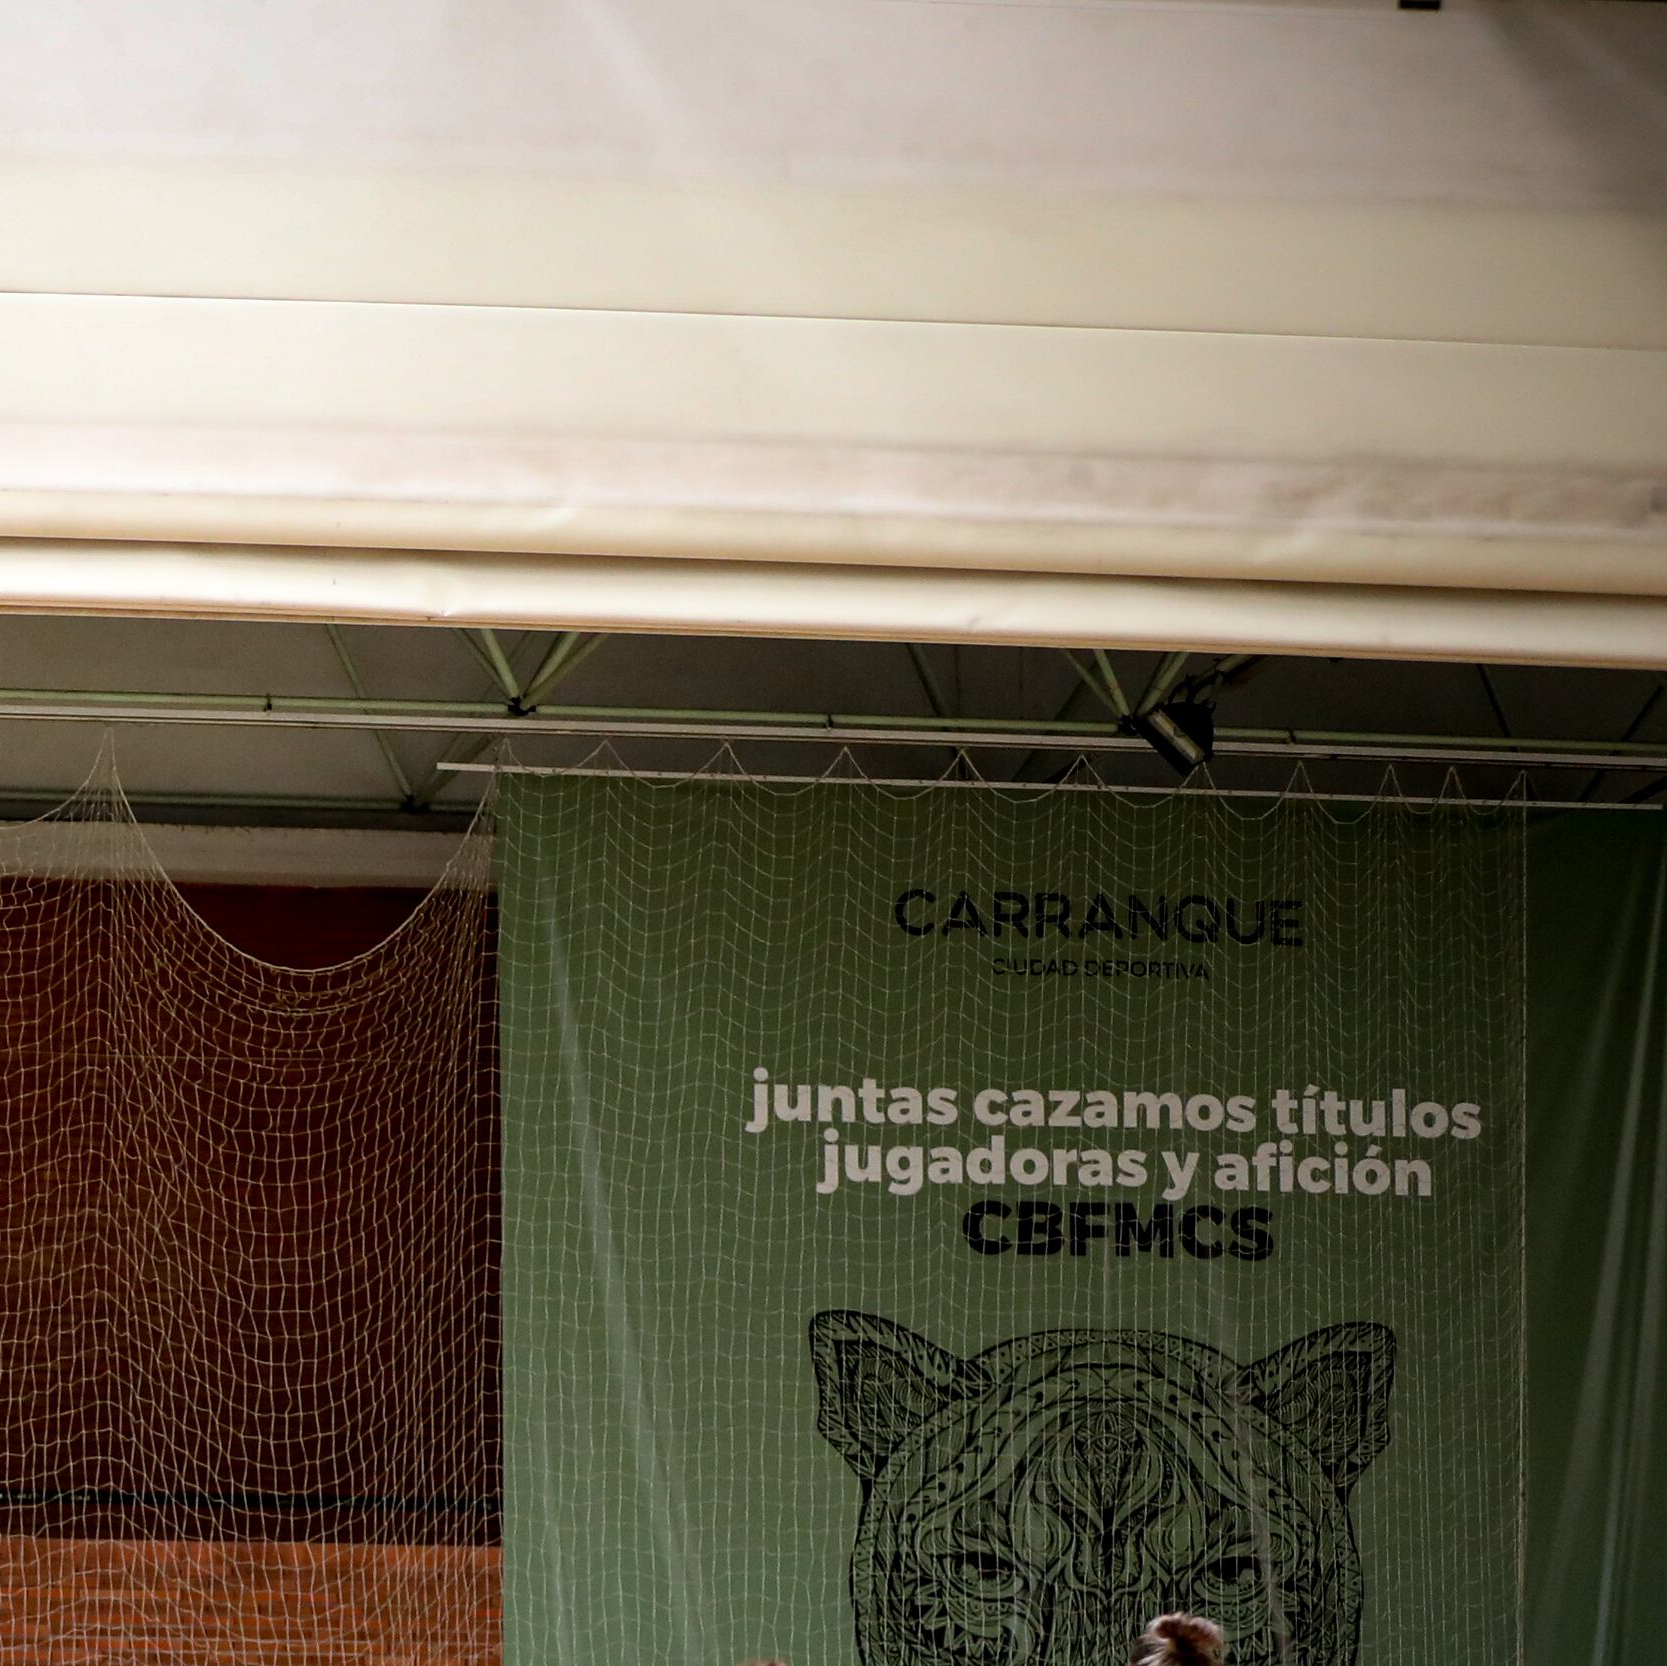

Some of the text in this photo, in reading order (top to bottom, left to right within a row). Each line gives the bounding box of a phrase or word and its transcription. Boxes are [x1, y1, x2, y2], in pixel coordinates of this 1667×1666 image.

[894, 889, 1304, 948] CARRANQUE
[992, 958, 1210, 981] CIUDAD DEPORTIVA
[746, 1068, 1482, 1140] juntas cazamos títulos
[816, 1129, 1432, 1200] jugadoras y afición
[963, 1200, 1275, 1262] CBFMCS
